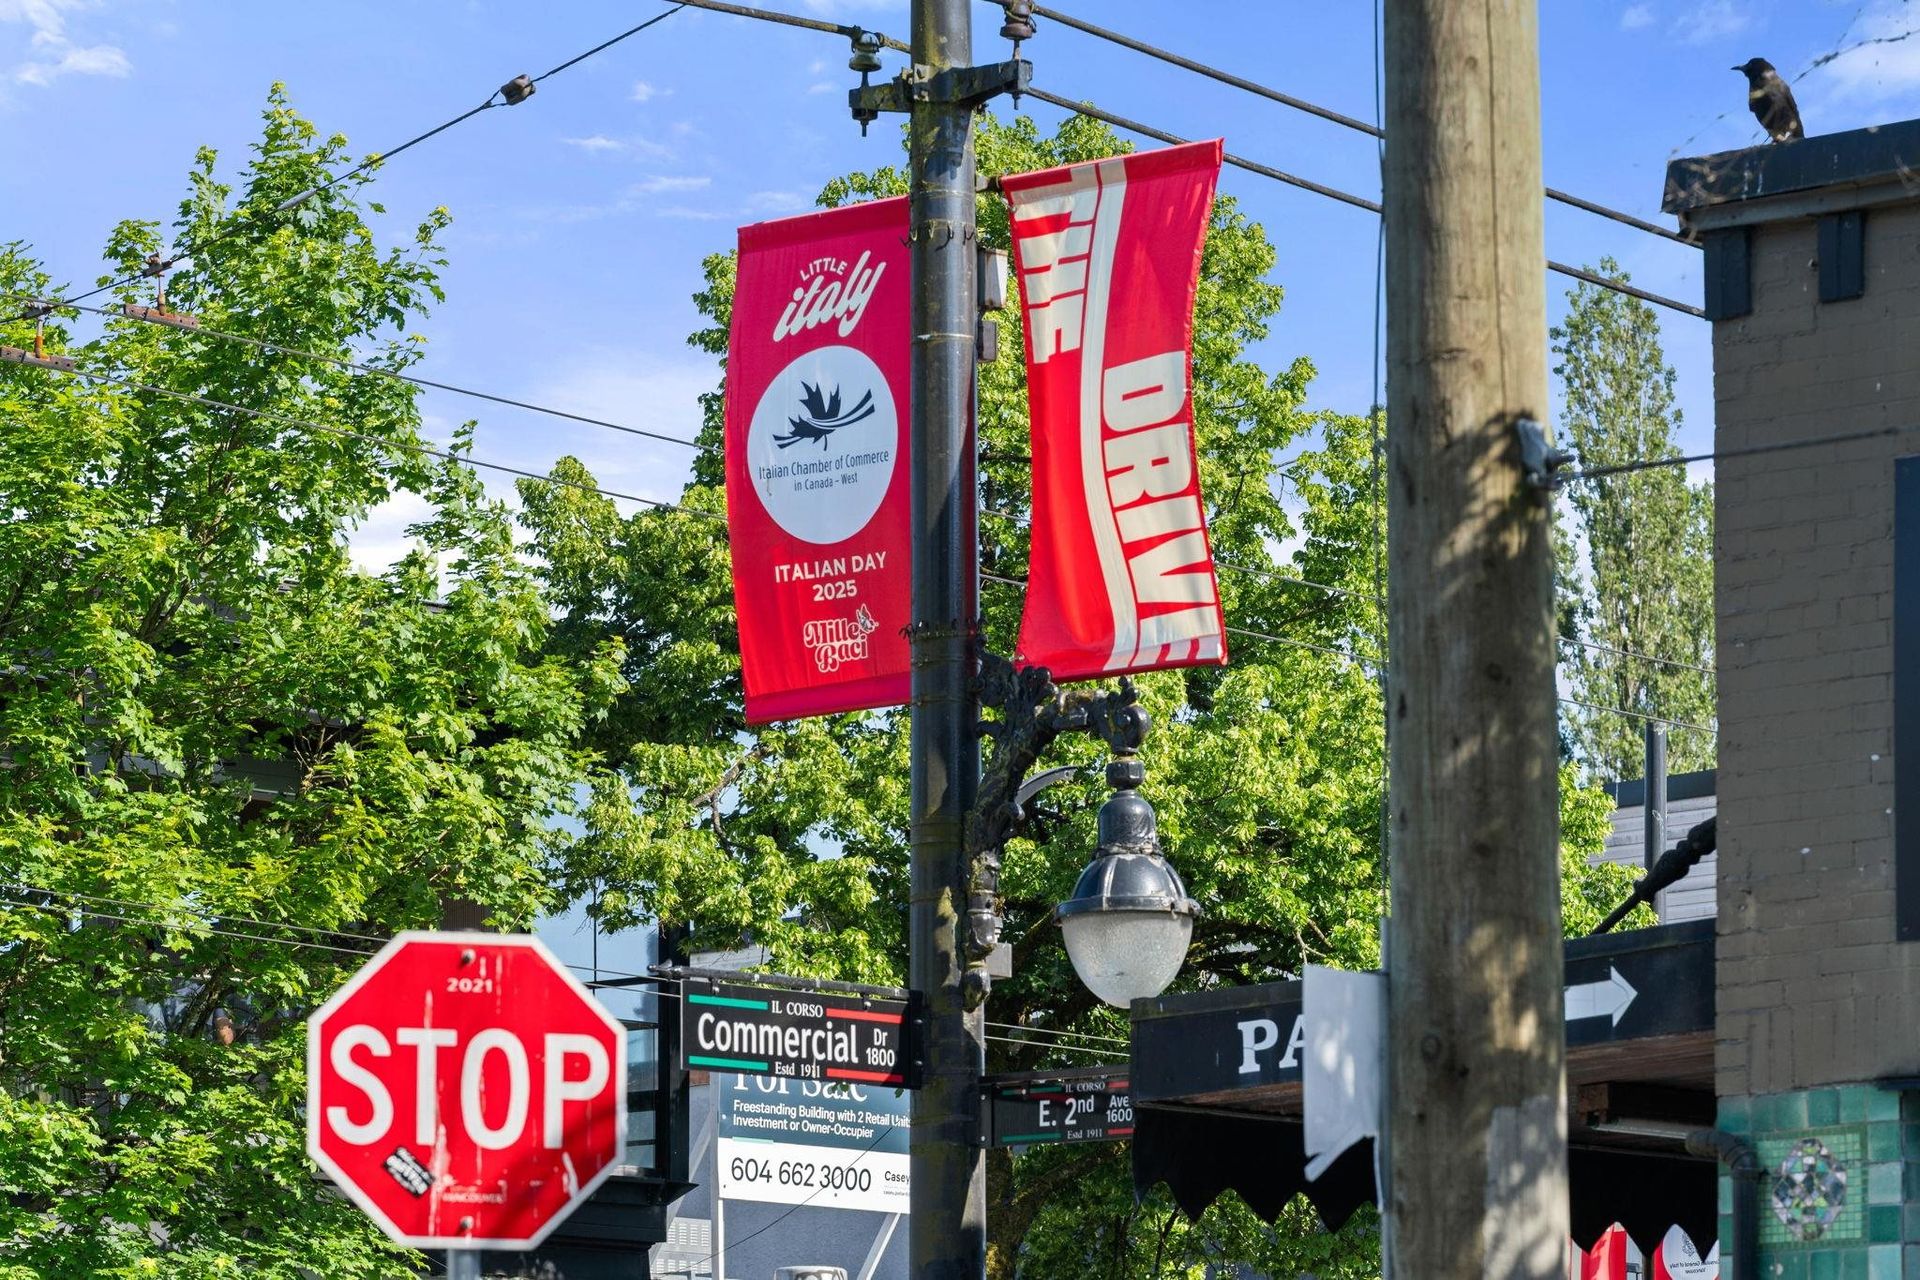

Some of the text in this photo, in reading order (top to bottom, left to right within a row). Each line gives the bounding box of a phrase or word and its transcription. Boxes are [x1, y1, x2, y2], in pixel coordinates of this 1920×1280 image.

[800, 257, 848, 281] LITTLE
[1010, 163, 1099, 364] THE
[772, 250, 887, 342] italy
[758, 450, 889, 480] Italian Chamber of Commerce
[794, 479, 802, 491] in
[804, 476, 833, 491] Canada
[840, 472, 858, 485] West
[1102, 350, 1222, 668] DRIVE
[774, 551, 887, 583] ITALIAN DAY
[812, 580, 857, 602] 2025
[815, 634, 869, 673] Baci
[446, 977, 493, 993] 2021
[771, 1000, 823, 1018] IL CORSO
[698, 1012, 888, 1064] Commercial Dr
[774, 1061, 820, 1079] Estd 1911
[865, 1047, 895, 1067] 1800
[326, 1024, 610, 1151] STOP
[1065, 1081, 1106, 1093] IL CORSO
[733, 1099, 796, 1118] Freestanding
[799, 1104, 835, 1123] Building
[837, 1109, 856, 1123] with
[858, 1111, 864, 1123] 2
[865, 1111, 890, 1126] Retail
[1038, 1094, 1129, 1128] E. 2nd Ave
[1106, 1108, 1133, 1123] 1600
[733, 1113, 874, 1140] Investment or Owner-Occupier
[1086, 1128, 1103, 1138] 1911
[731, 1156, 872, 1192] 604 662 3000
